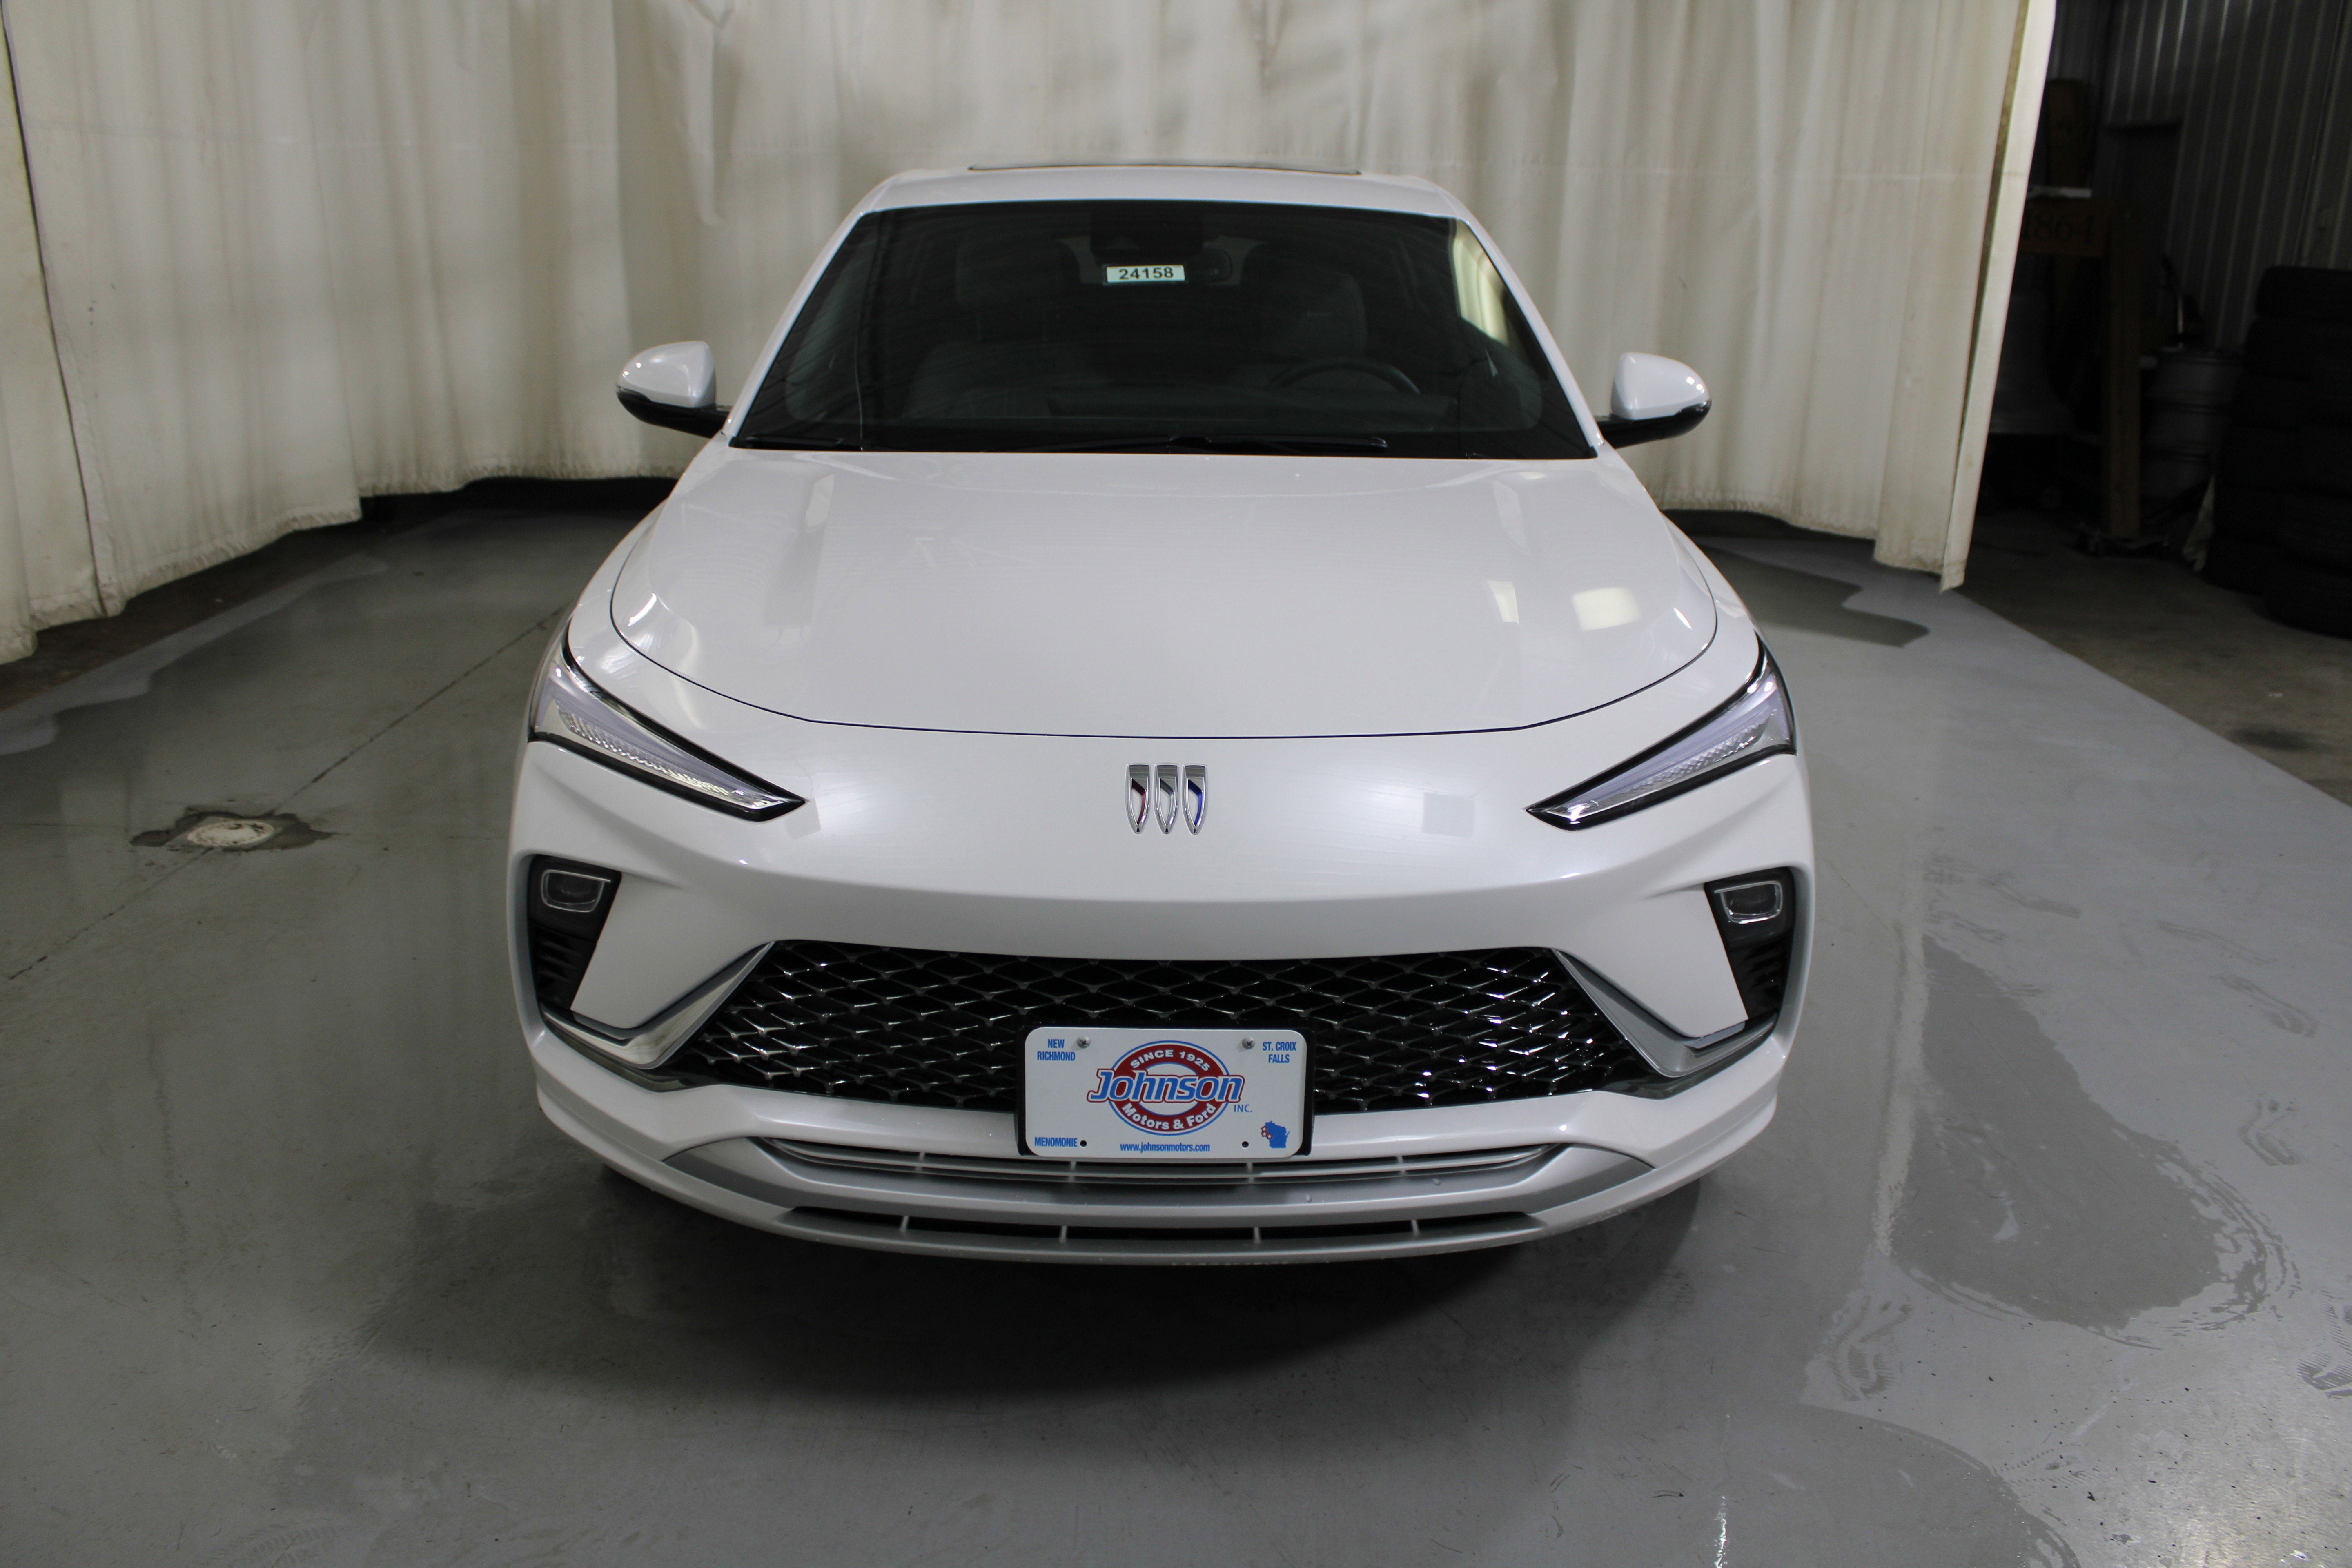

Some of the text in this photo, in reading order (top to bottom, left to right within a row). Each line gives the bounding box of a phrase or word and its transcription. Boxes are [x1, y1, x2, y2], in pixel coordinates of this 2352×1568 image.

[1118, 267, 1174, 281] 24158
[1048, 1039, 1065, 1048] NEW
[1263, 1042, 1297, 1051] ST. CROIX
[1037, 1051, 1076, 1061] RICHMOND
[1130, 1049, 1211, 1071] SINCE 1925
[1268, 1054, 1290, 1063] FALLS
[1088, 1069, 1244, 1102] Johnson
[1234, 1104, 1253, 1113] INC.
[1121, 1102, 1217, 1130] Motors & Ford
[1034, 1137, 1078, 1147] MENOMONIE
[1120, 1142, 1210, 1153] www.johnsonmotors.com
